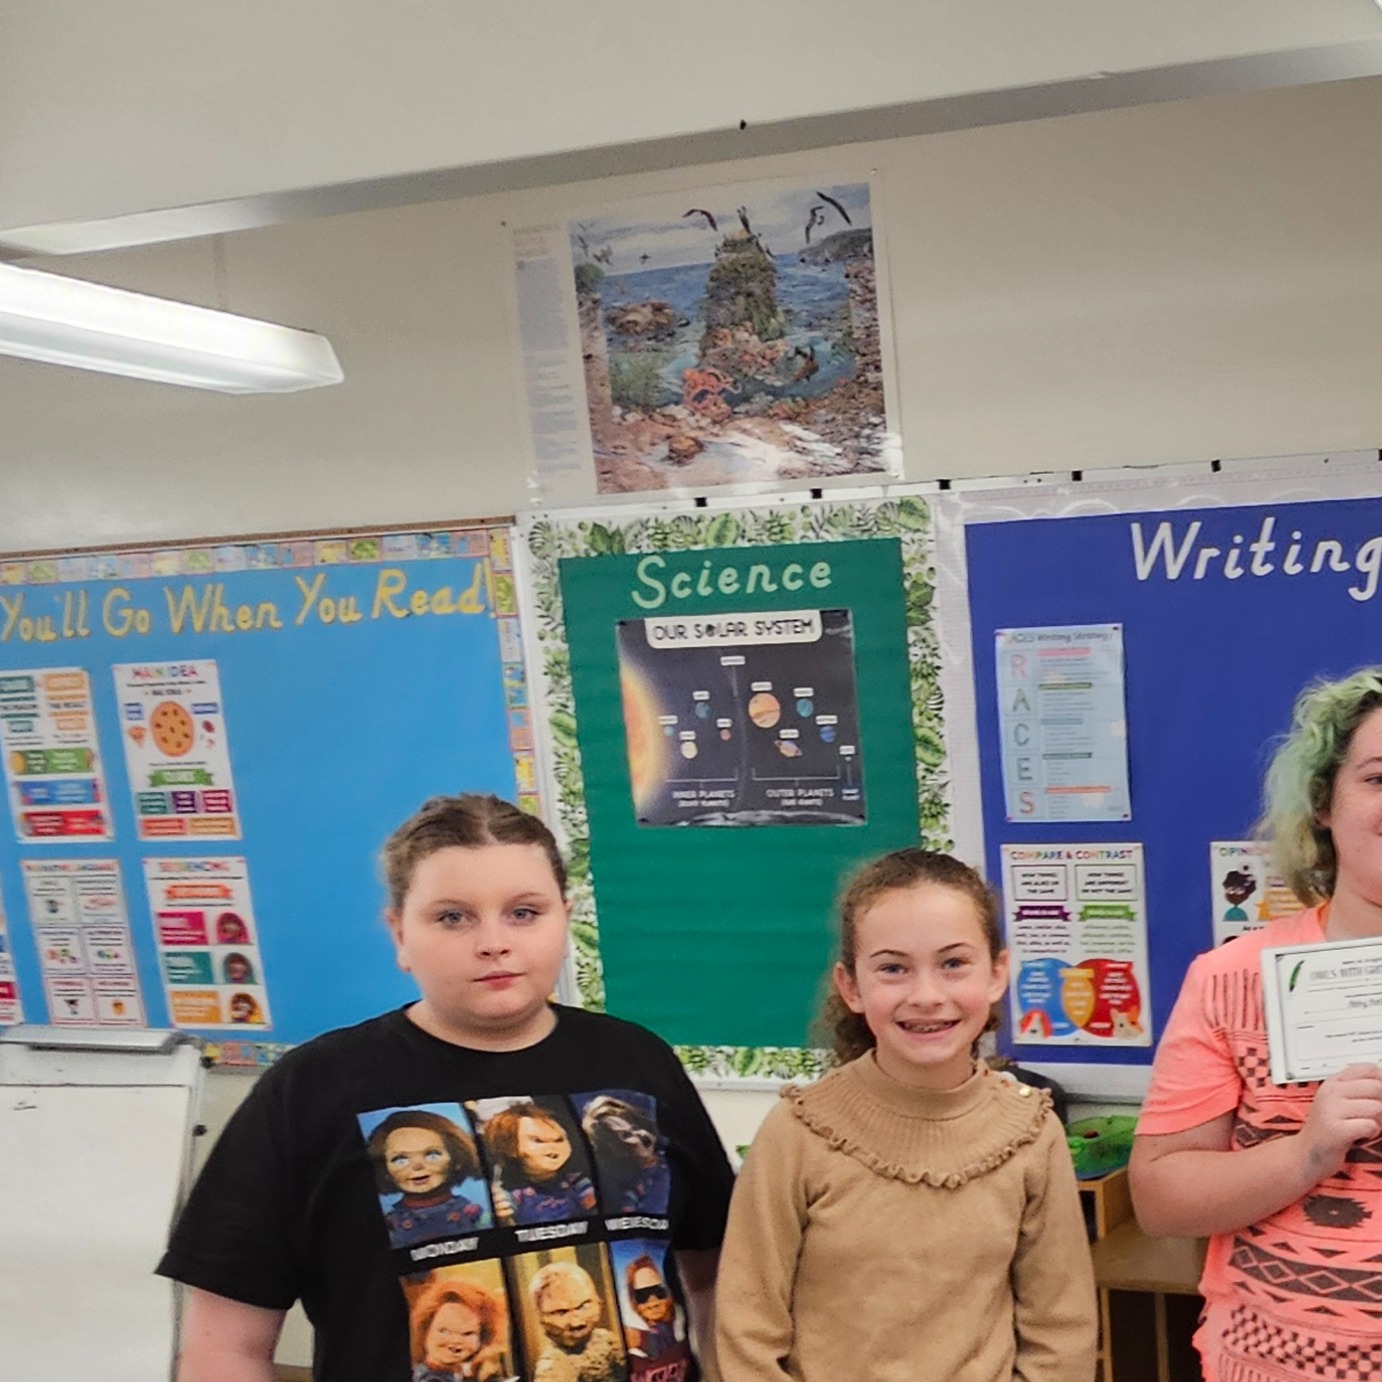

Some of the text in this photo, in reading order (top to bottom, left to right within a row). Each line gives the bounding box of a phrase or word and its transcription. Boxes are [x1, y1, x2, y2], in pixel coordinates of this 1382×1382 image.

[631, 555, 832, 609] Science
[102, 587, 151, 638] Go
[164, 582, 283, 636] When
[294, 572, 364, 626] You
[370, 557, 499, 620] Read!
[652, 618, 815, 640] OUR SOLAR SYSTEM
[1010, 653, 1028, 678] R
[1012, 688, 1030, 712] A
[1013, 723, 1030, 746] C
[1016, 757, 1033, 781] E
[699, 789, 736, 798] PLANETS
[765, 788, 795, 798] OUTER
[798, 787, 835, 798] PLANETS
[1019, 791, 1035, 815] S
[1011, 850, 1063, 860] COMPARE
[1075, 849, 1133, 860] CONTRAST
[514, 1221, 589, 1243] TUESDAY
[409, 1236, 480, 1262] MONDAY
